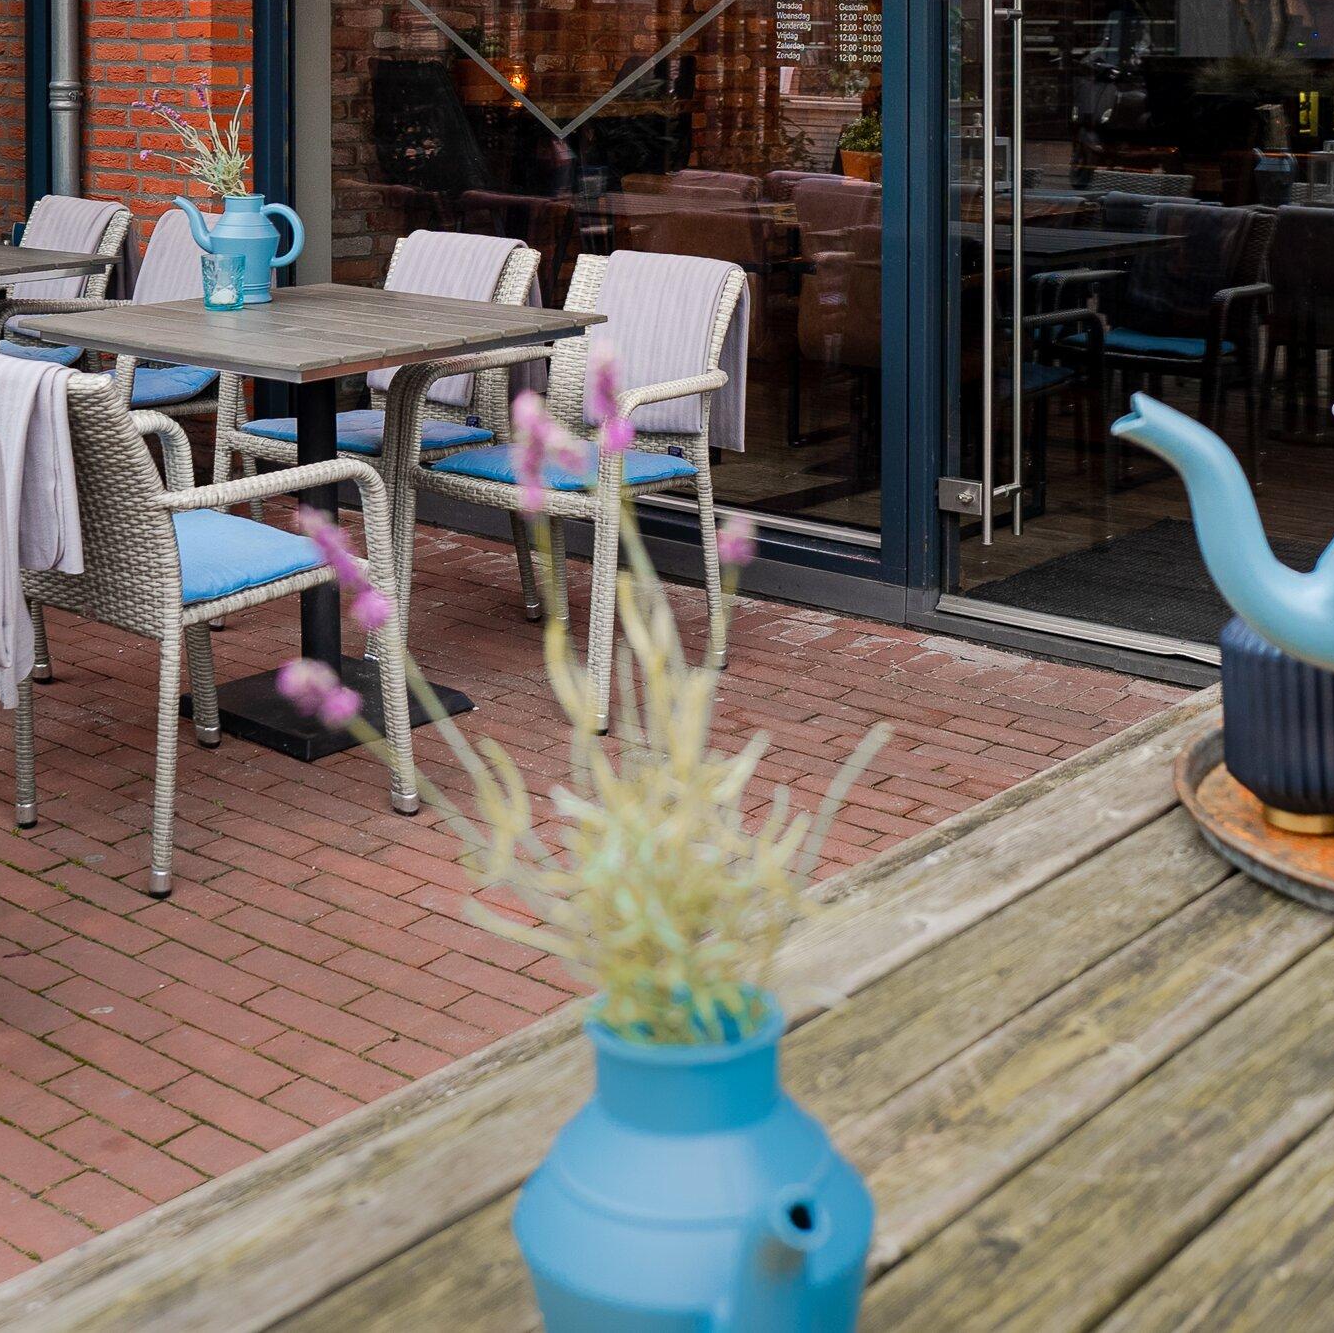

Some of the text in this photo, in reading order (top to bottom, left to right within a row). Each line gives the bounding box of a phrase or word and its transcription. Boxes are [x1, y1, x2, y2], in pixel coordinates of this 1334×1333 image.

[776, 1, 803, 10] Dinsdag
[838, 2, 869, 11] Gesloten
[776, 12, 811, 22] Woensdag
[839, 14, 857, 22] 12:00
[863, 14, 882, 22] 00:00
[776, 22, 812, 31] Donderdag
[839, 24, 857, 32] 12:00
[863, 24, 882, 32] 00:00
[776, 32, 799, 41] Vrijdag
[839, 34, 857, 42] 12:00
[863, 34, 882, 42] 01:00
[776, 42, 805, 51] Zaterdag
[839, 44, 857, 52] 12:00
[863, 44, 882, 52] 01:00
[776, 52, 801, 61] Zondag
[839, 54, 857, 62] 12:00
[863, 54, 882, 62] 00:00
